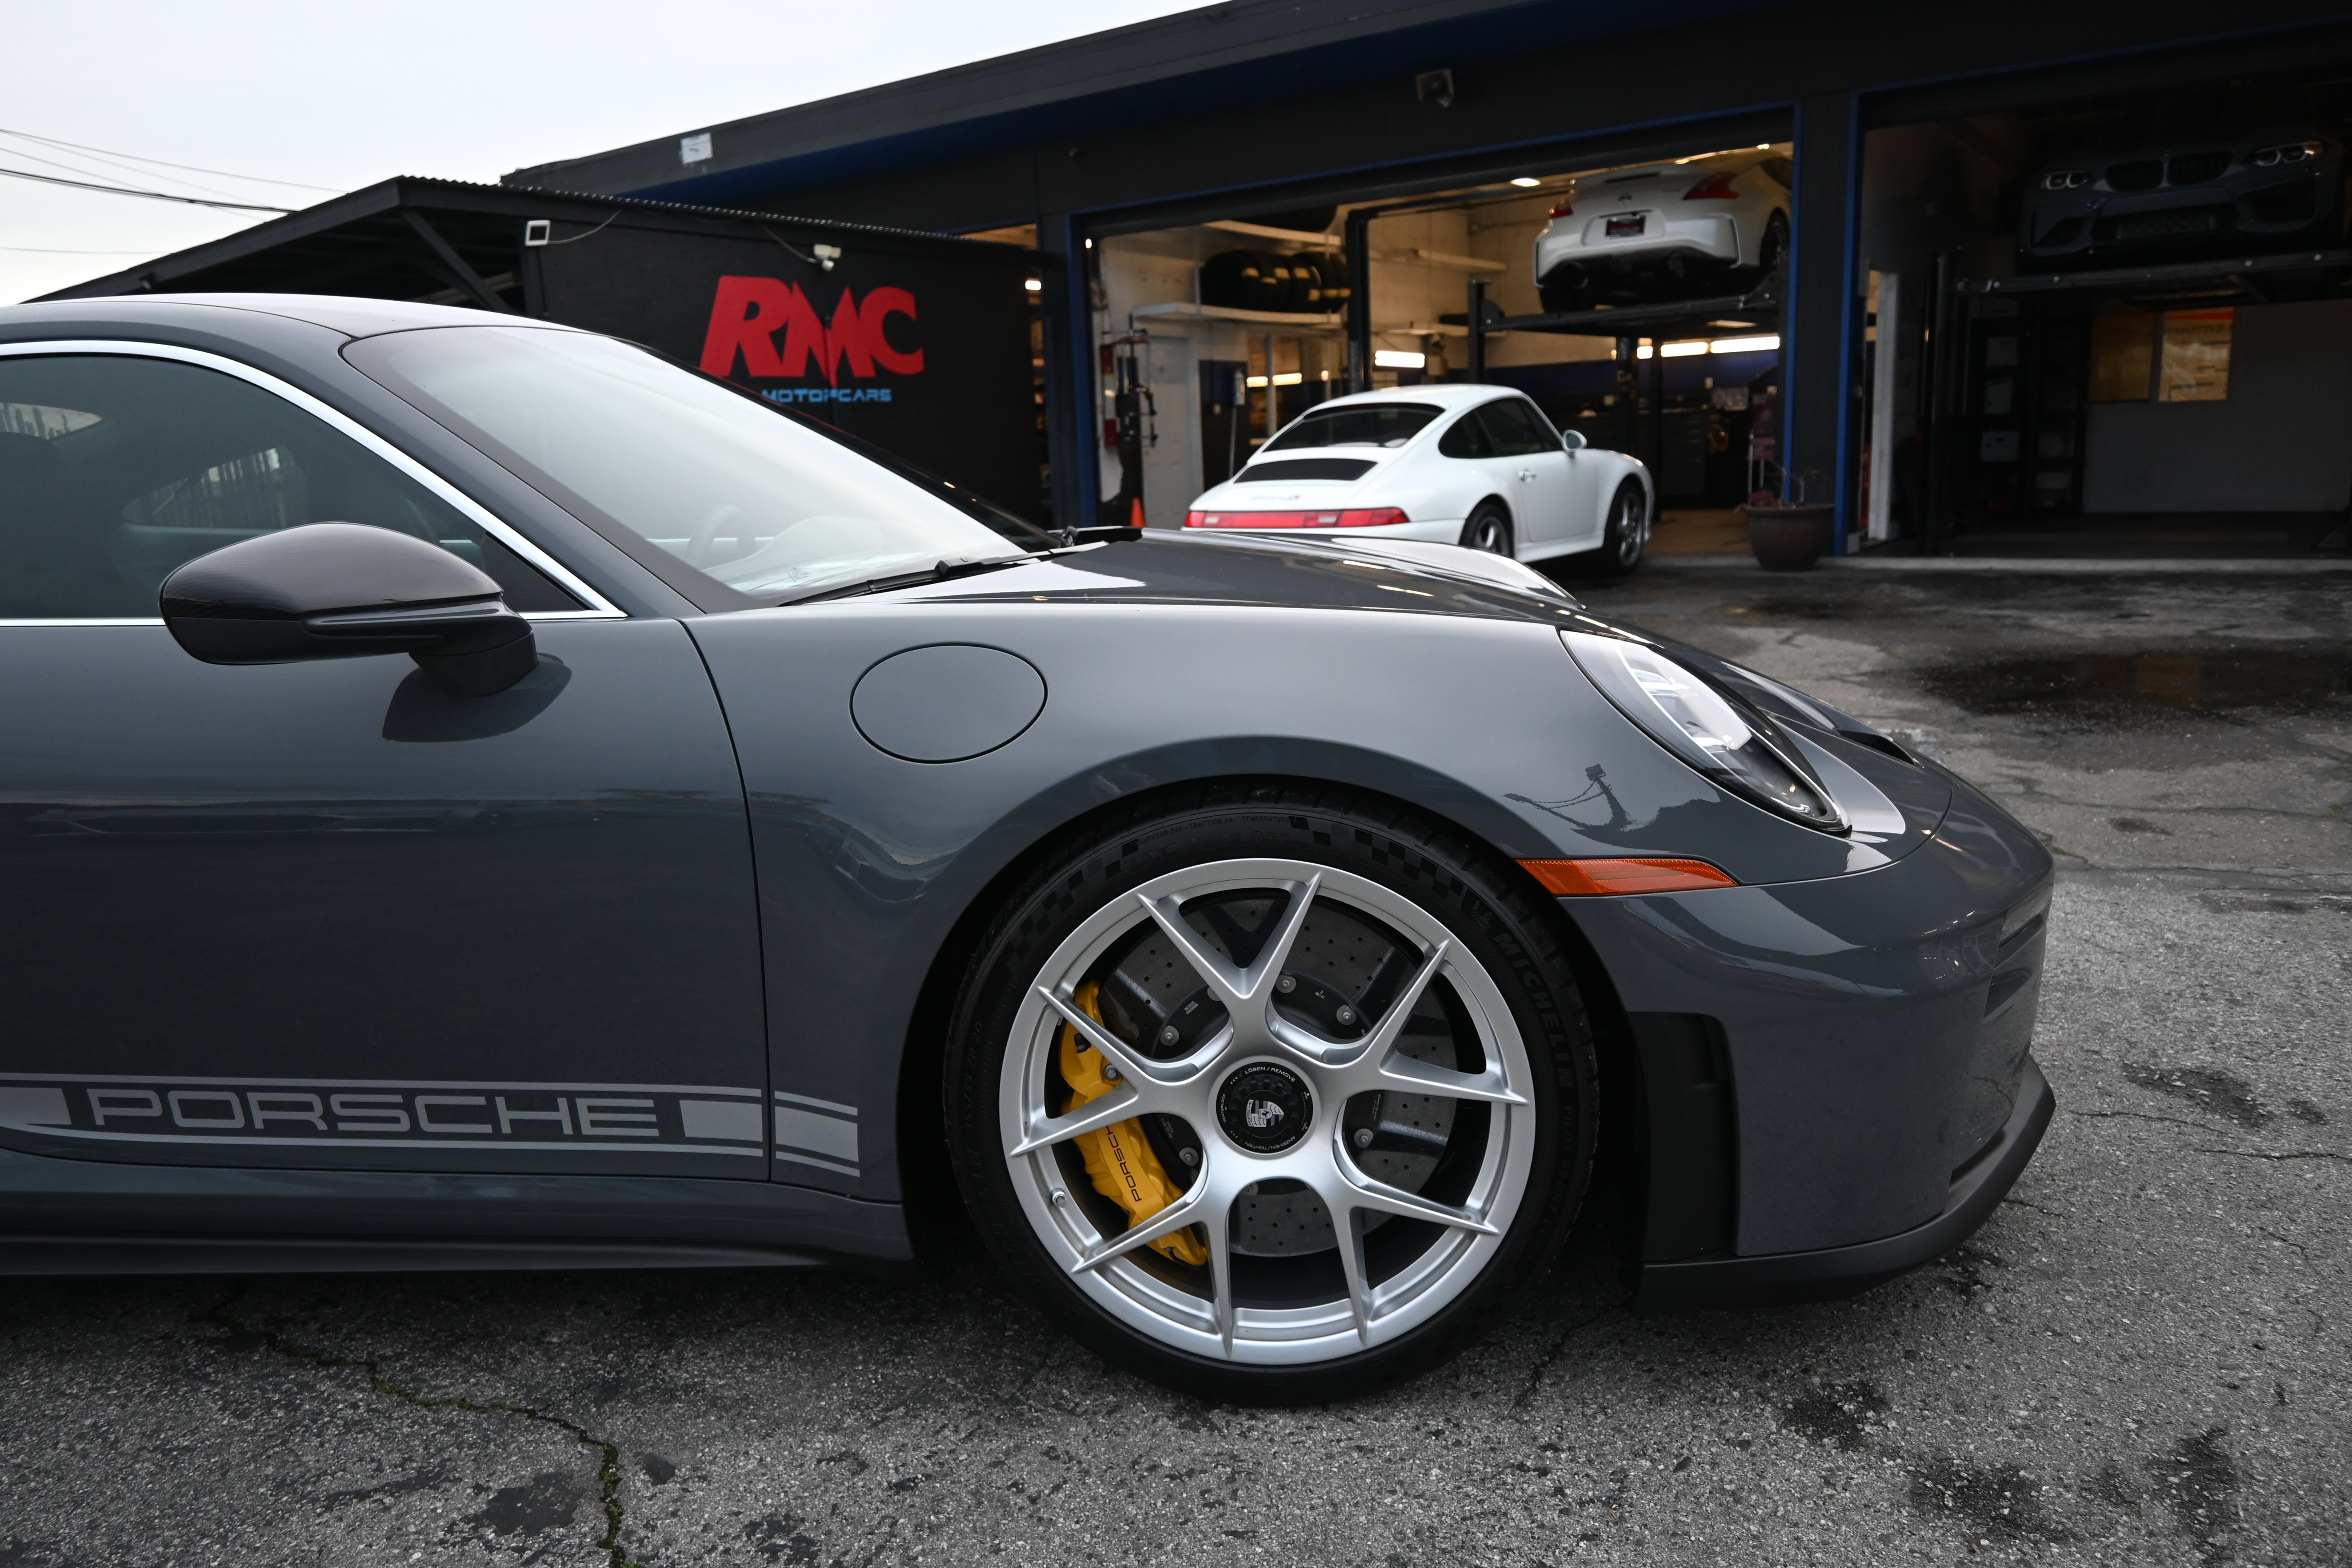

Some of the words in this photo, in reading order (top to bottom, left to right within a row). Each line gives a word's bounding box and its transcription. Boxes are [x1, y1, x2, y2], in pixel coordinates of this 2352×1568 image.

[700, 275, 924, 388] RMC
[1493, 932, 1573, 1088] MICHELIN
[1271, 1067, 1296, 1083] REMOVE
[87, 1089, 659, 1137] PORSCHE
[1561, 1106, 1573, 1154] PILOT
